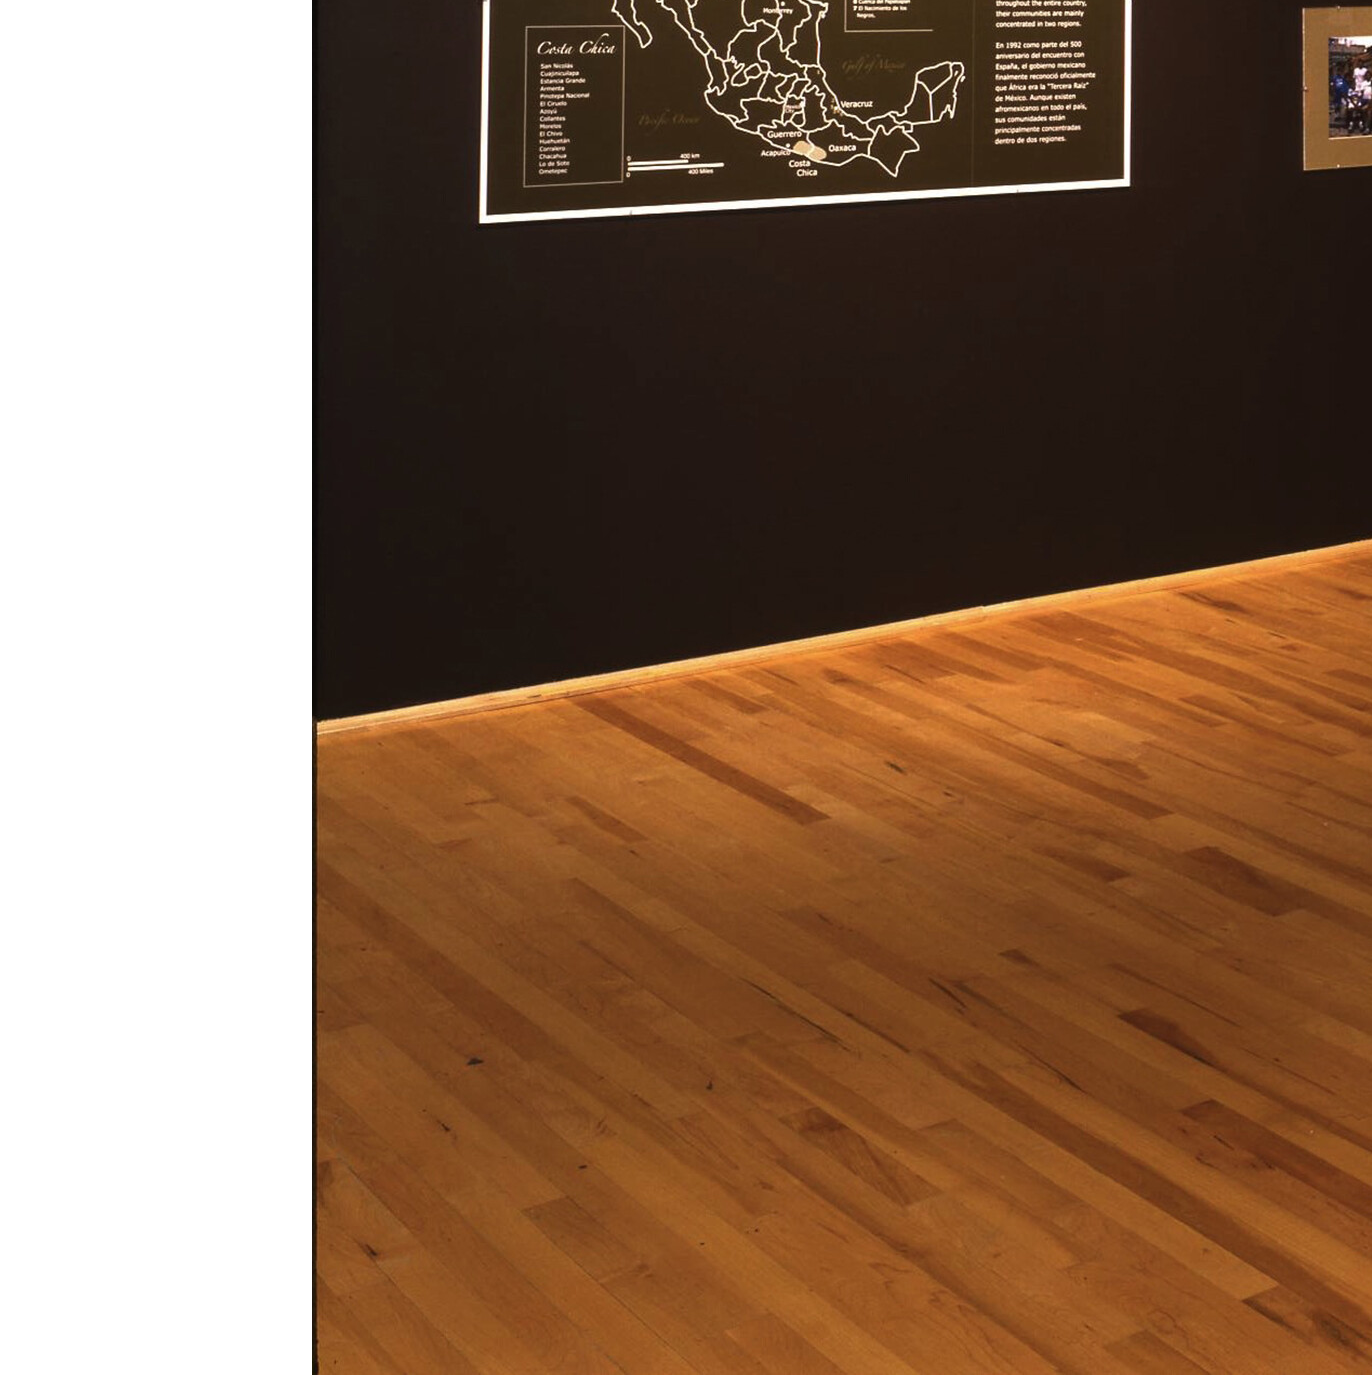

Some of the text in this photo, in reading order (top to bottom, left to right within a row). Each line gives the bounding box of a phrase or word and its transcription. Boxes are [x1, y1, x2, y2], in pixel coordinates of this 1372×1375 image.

[996, 0, 1030, 8] throughout
[537, 33, 616, 55] Costa Chica
[1008, 83, 1026, 91] África
[760, 149, 791, 157] Acapulco
